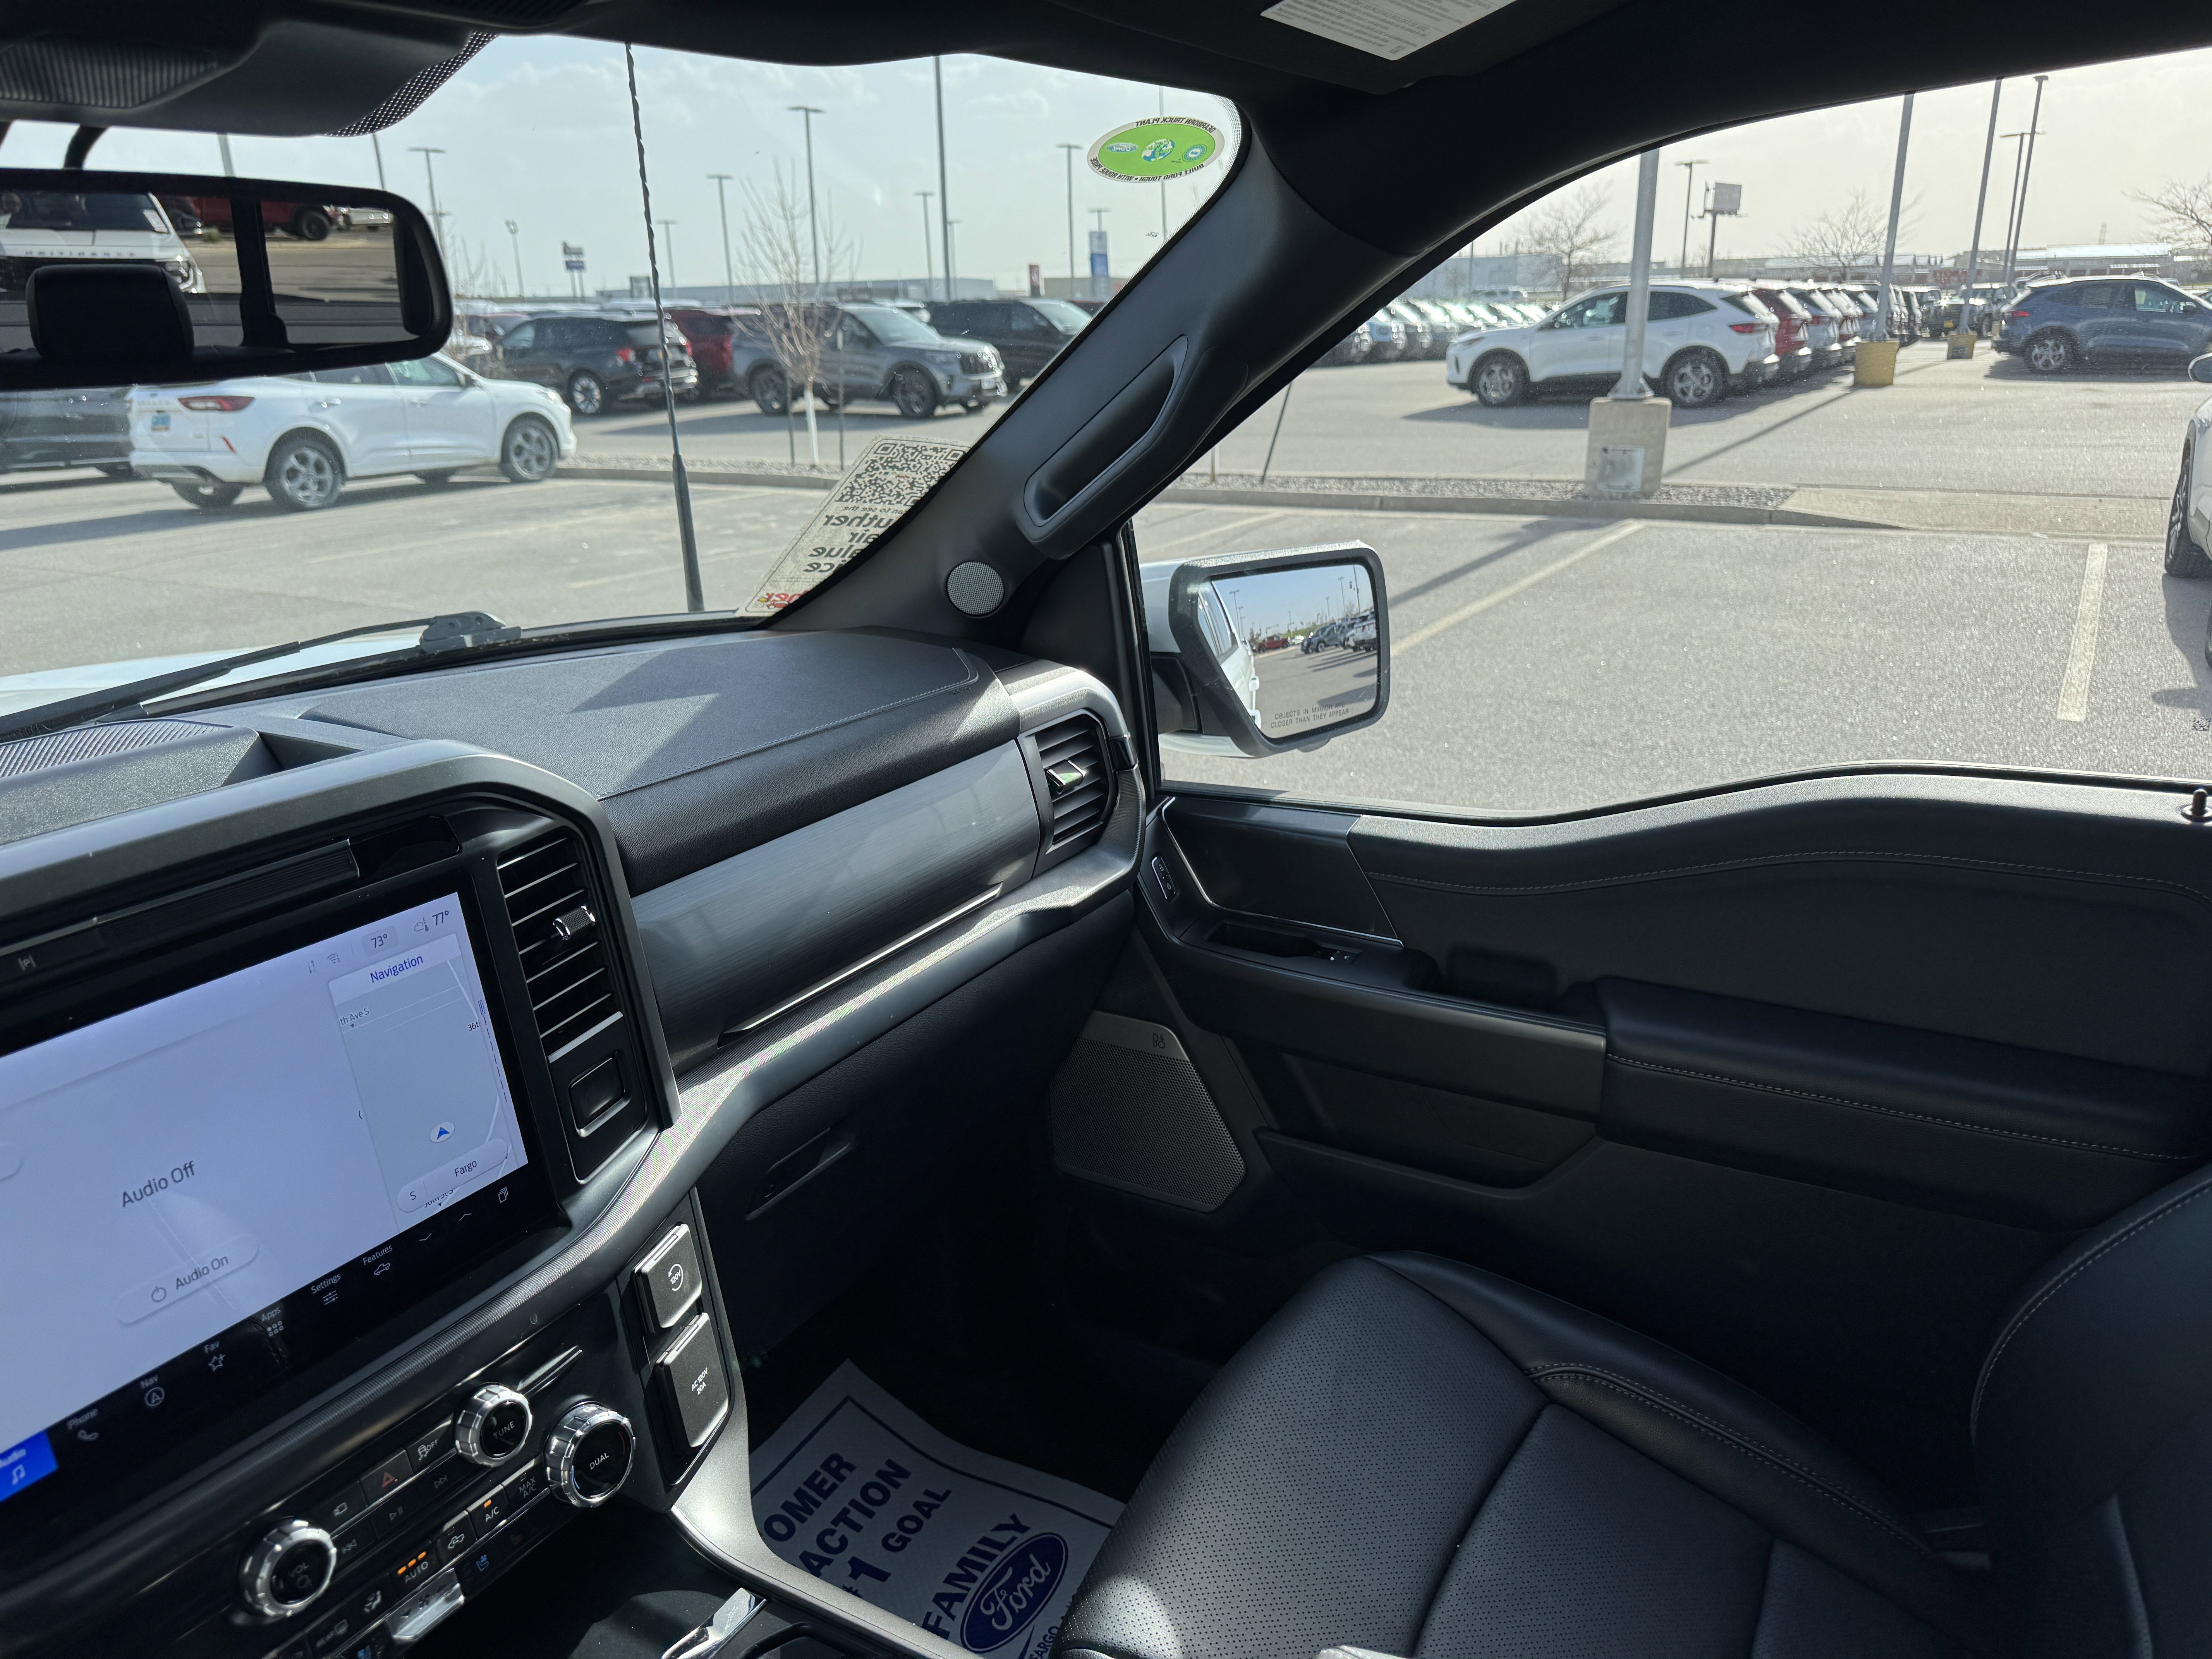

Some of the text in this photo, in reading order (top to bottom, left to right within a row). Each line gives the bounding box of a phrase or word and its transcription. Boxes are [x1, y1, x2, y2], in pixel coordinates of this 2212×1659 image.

[1271, 718, 1293, 728] CLOSER
[1329, 708, 1349, 717] APPEAR
[1274, 709, 1300, 720] OBJECTS
[1312, 704, 1332, 713] MIRROR
[432, 910, 449, 926] 77°
[371, 934, 388, 948] 73°
[370, 956, 424, 982] Navigation
[350, 1012, 363, 1022] Ave
[454, 1161, 477, 1177] Fargo
[122, 1161, 195, 1208] Audio Off
[410, 1191, 416, 1201] S
[362, 1244, 393, 1265] Features
[175, 1255, 229, 1290] Audio On
[670, 1269, 681, 1285] 120V
[311, 1273, 341, 1294] Settings
[261, 1306, 281, 1322] Apps
[204, 1340, 220, 1354] Fav
[140, 1375, 159, 1389] Nav
[691, 1367, 708, 1391] AC 120V
[697, 1381, 706, 1395] 20A
[66, 1408, 98, 1431] Phone
[493, 1421, 515, 1439] TUNE
[426, 1439, 439, 1452] OFF
[589, 1452, 610, 1470] DUAL
[519, 1477, 536, 1493] MAX
[523, 1484, 537, 1498] A/C
[486, 1506, 500, 1522] A/C
[881, 1489, 952, 1553] GOAL
[405, 1561, 428, 1583] AUTO
[922, 1513, 1031, 1640] FAMILY
[980, 1553, 1051, 1630] Ford
